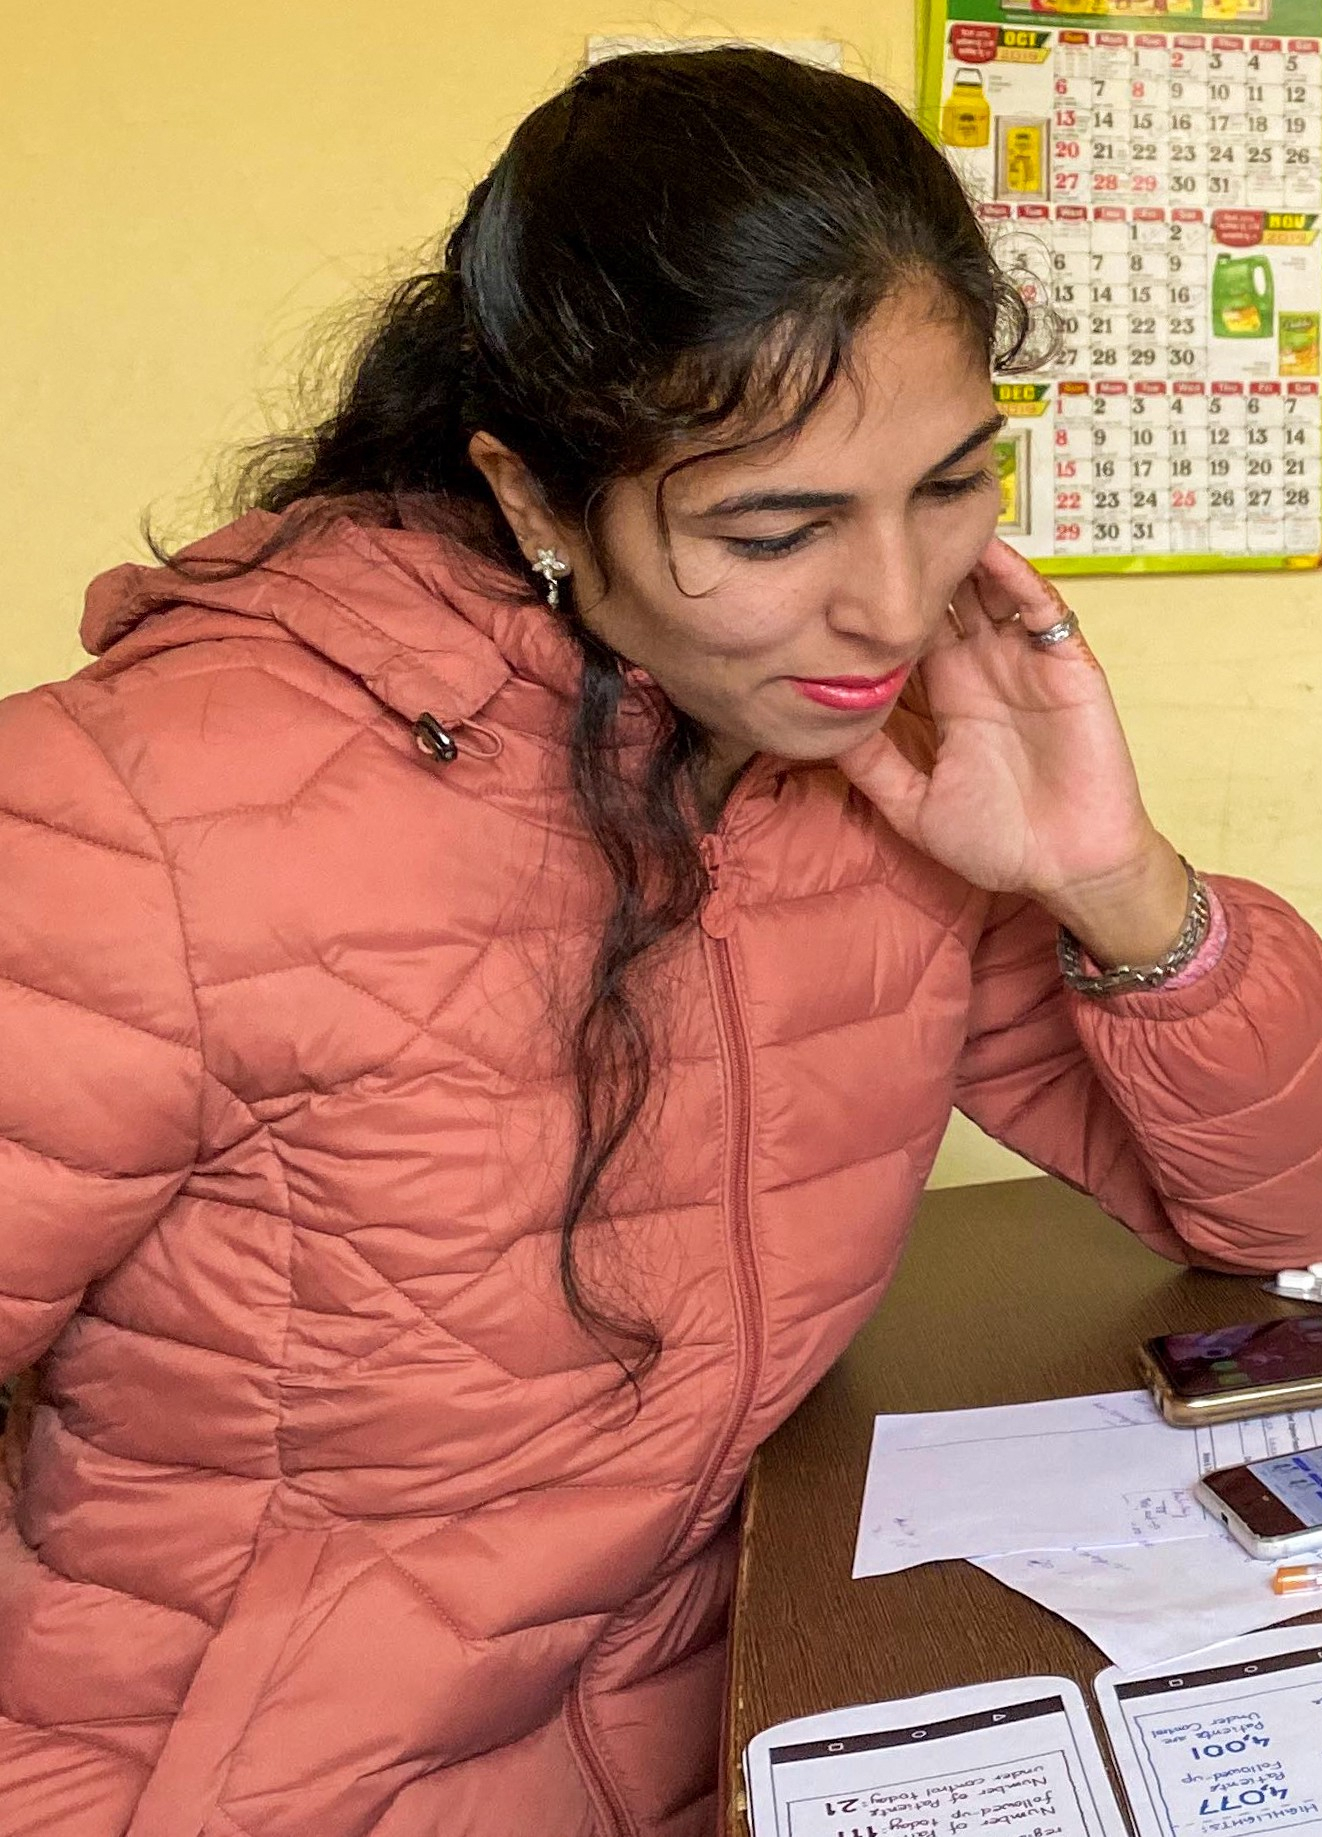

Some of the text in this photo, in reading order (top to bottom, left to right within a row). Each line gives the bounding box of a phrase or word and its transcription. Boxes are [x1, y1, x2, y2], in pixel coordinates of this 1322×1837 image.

[1004, 31, 1037, 46] OCT
[1209, 53, 1298, 71] 3 4 5
[1056, 110, 1306, 133] 13 14 15 16 17 18 19
[1055, 141, 1234, 162] 20 21 22 23 24
[1269, 214, 1305, 229] NOV
[1000, 385, 1035, 399] DEC
[1064, 383, 1084, 392] Sun
[1057, 398, 1297, 414] 1 2 3 4 5 6 7
[1056, 428, 1305, 446] 8 9 10 11 12 13 14
[1057, 459, 1304, 477] 15 16 17 18 19 20 21
[1056, 489, 1310, 509] 22 23 24 25 26 27 28
[1056, 523, 1080, 540] 29
[1095, 523, 1120, 540] 30
[1133, 523, 1154, 540] 31
[1163, 1721, 1264, 1744] Patients are
[1192, 1734, 1270, 1760] 4,001
[826, 1766, 1044, 1816] under control 21
[1210, 1772, 1285, 1792] Patients
[870, 1777, 1047, 1816] Number of Patients
[1200, 1784, 1288, 1815] 4,077
[950, 1806, 1055, 1835] Number of
